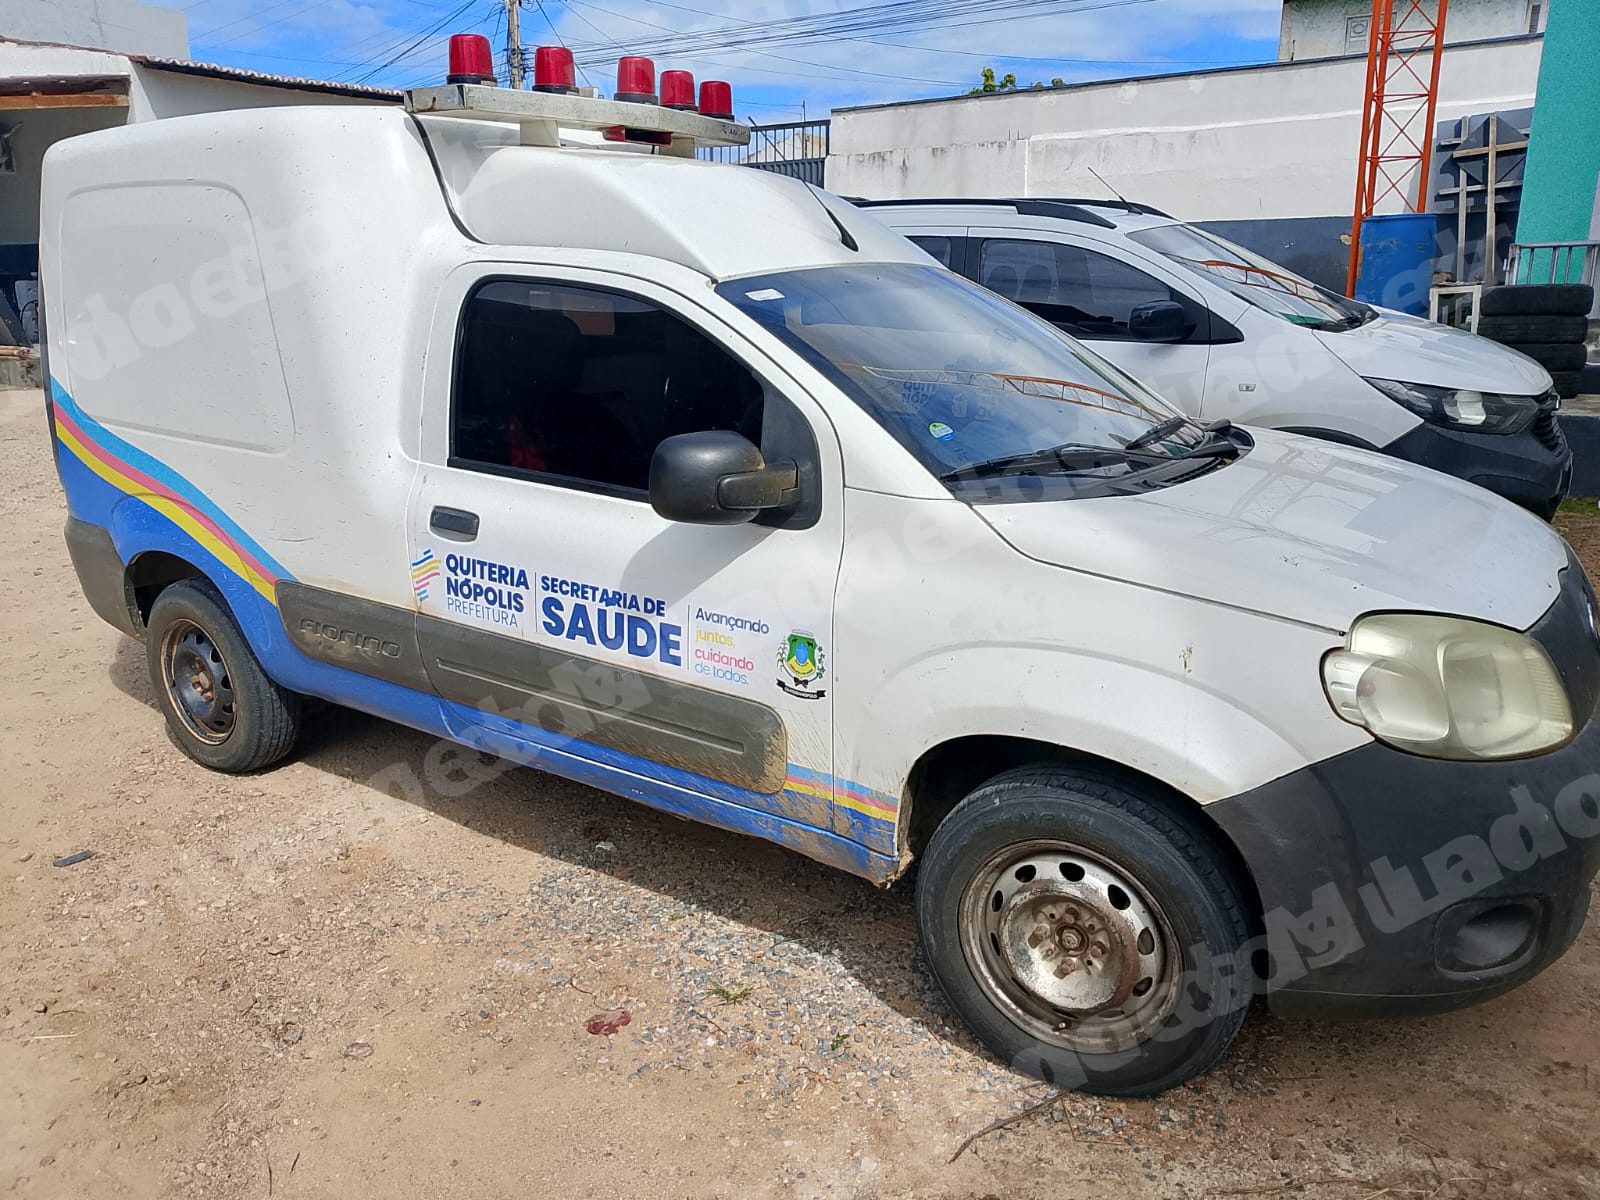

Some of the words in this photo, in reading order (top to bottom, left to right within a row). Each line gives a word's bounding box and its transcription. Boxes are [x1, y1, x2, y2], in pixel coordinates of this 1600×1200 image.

[446, 554, 529, 590] QUITERIA
[446, 575, 525, 614] NÓPOLIS
[541, 575, 640, 612] SECRETARIA
[643, 597, 665, 616] DE
[446, 597, 518, 628] PREFEITURA
[695, 607, 770, 635] Avançando
[541, 594, 681, 666] SAÚDE
[694, 647, 755, 672] cuidando
[695, 662, 711, 676] de
[712, 665, 750, 686] todos.
